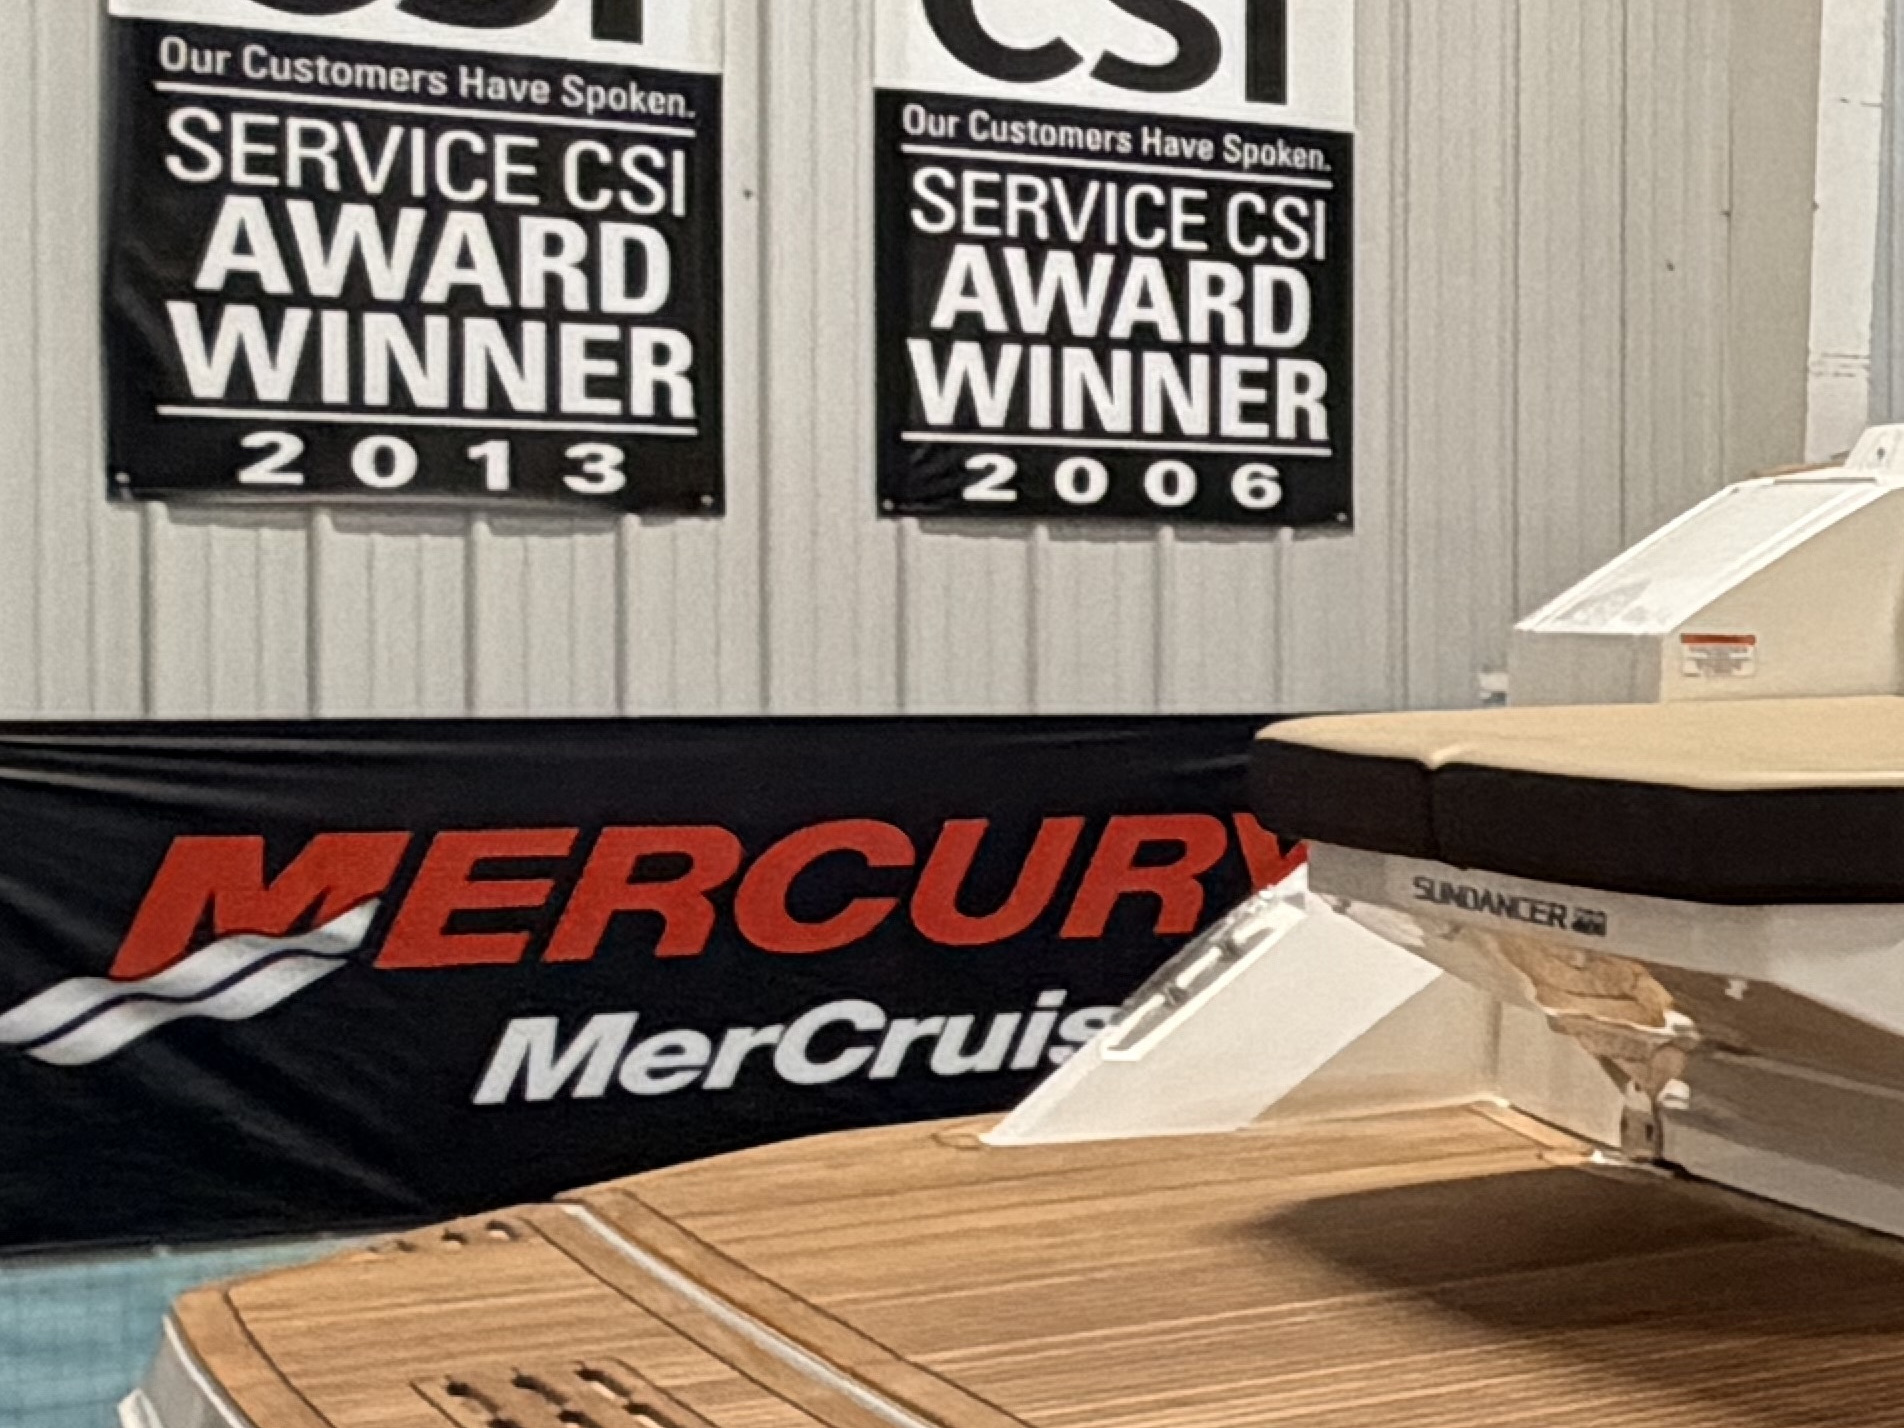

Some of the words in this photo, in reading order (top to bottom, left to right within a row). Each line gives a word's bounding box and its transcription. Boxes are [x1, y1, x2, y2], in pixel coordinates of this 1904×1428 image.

[159, 35, 232, 78] Our
[241, 44, 448, 95] Customers
[459, 66, 552, 106] Have
[561, 74, 697, 122] Spoken.
[165, 107, 538, 206] SERVICE
[563, 139, 686, 218] CSI
[902, 103, 959, 138] Our
[966, 110, 1131, 154] Customers
[1139, 128, 1213, 160] Have
[1220, 134, 1331, 173] Spoken.
[196, 195, 672, 317] AWARD
[910, 166, 1207, 252] SERVICE
[1226, 192, 1327, 260] CSI
[930, 243, 1312, 348] AWARD
[168, 301, 698, 420] WINNER
[908, 337, 1330, 443] WINNER
[239, 428, 630, 496] 2013
[964, 454, 1283, 509] 2006
[110, 811, 1309, 980] MERCURY
[1412, 875, 1567, 930] SUNDANCER
